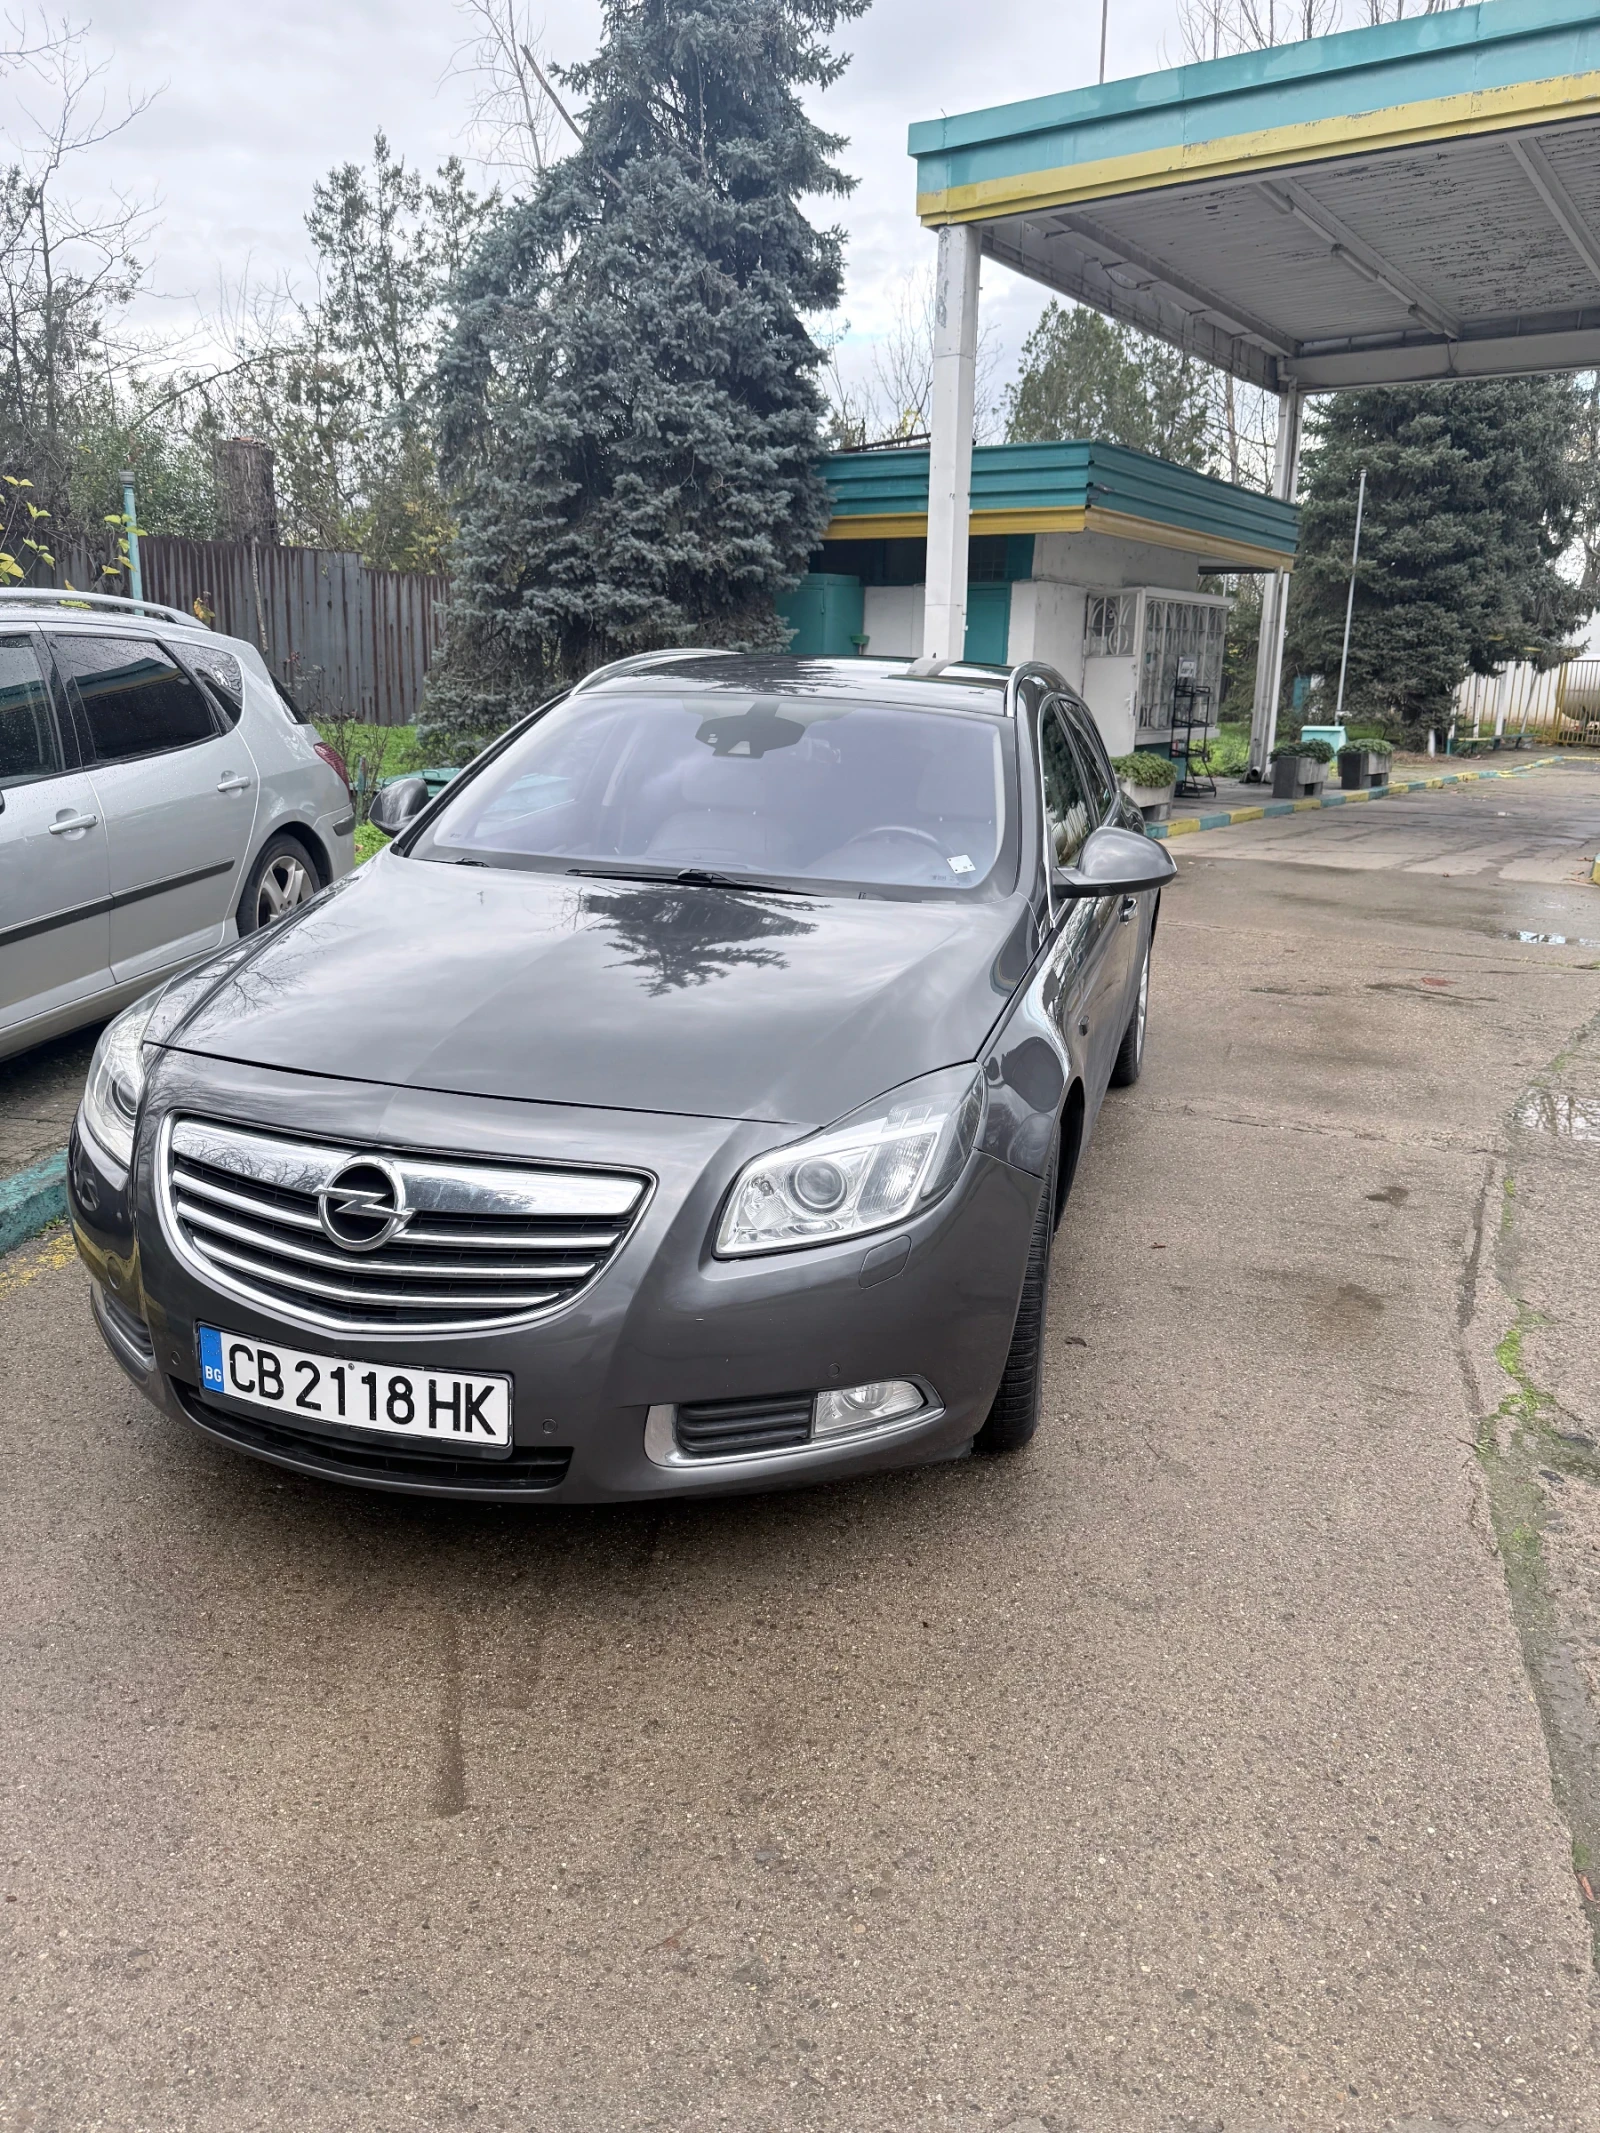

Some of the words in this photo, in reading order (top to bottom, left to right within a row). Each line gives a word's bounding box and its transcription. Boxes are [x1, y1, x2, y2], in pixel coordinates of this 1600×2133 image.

[205, 1365, 222, 1383] BG
[229, 1343, 284, 1401] CB
[295, 1360, 415, 1425] 2118
[428, 1379, 497, 1436] HK
